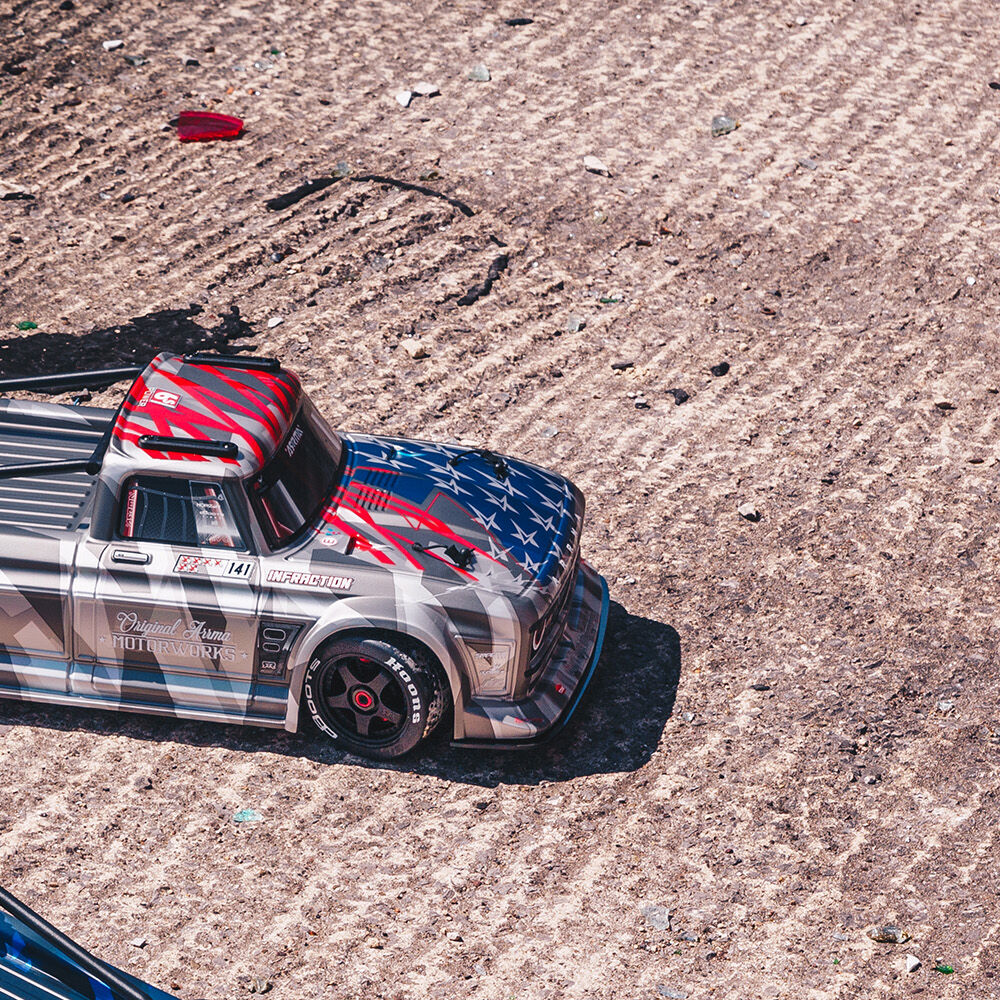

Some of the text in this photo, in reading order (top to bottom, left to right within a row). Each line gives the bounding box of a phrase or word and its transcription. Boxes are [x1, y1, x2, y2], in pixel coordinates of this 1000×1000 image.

[227, 561, 252, 577] 141
[267, 570, 354, 591] INFRACTION
[117, 612, 231, 641] Original Arrma
[112, 634, 237, 661] MOTORWORKS
